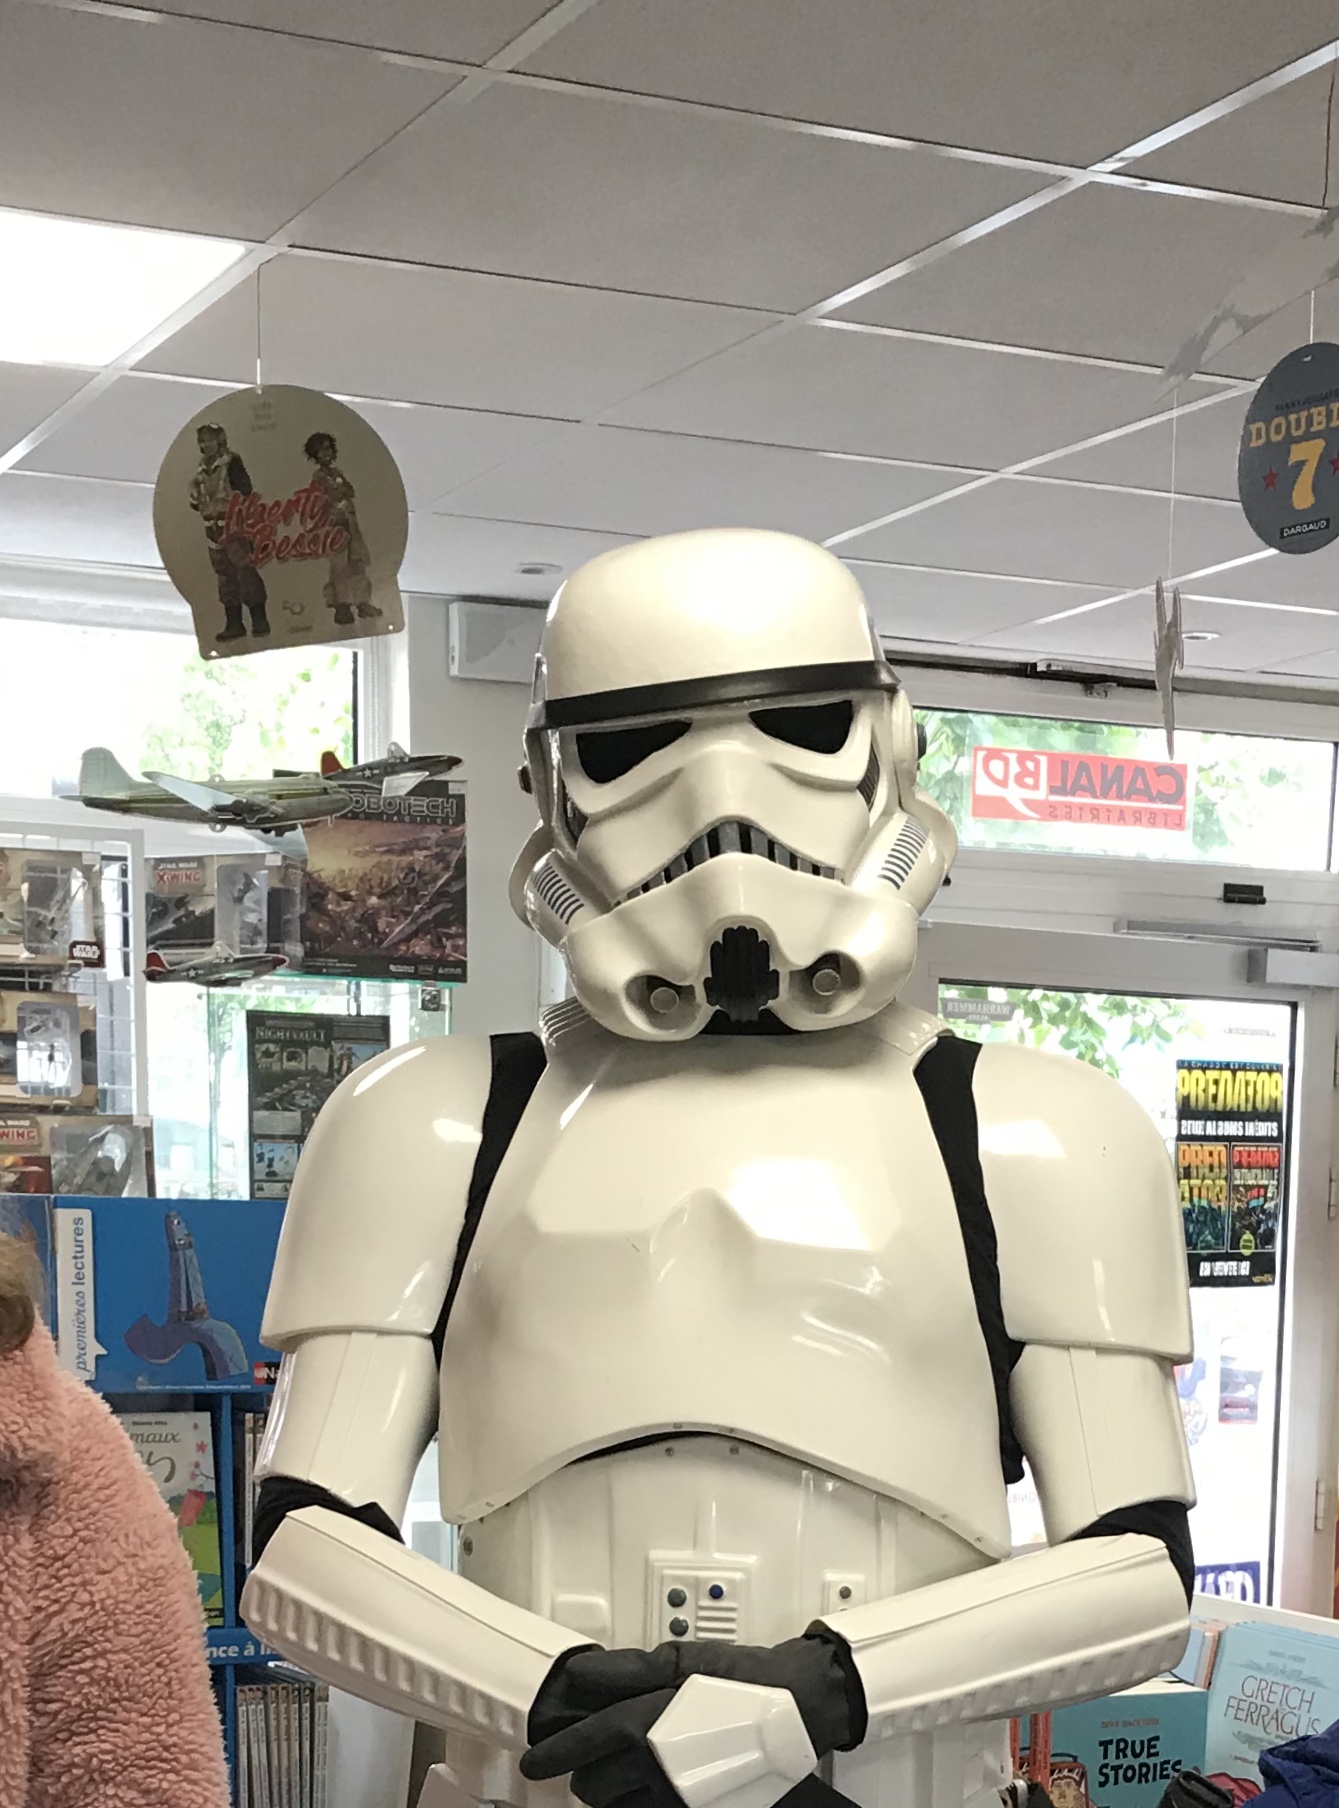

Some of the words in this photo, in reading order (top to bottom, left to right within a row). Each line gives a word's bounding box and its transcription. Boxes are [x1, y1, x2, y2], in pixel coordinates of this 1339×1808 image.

[1288, 438, 1326, 510] 7
[253, 523, 346, 568] Bessie
[1283, 520, 1326, 537] DARGAUD
[351, 793, 457, 817] OBOTECH
[1177, 1069, 1283, 1113] PREDATOR
[71, 1216, 86, 1286] lectures
[129, 1432, 181, 1443] maux
[1241, 1675, 1315, 1714] GRETCH
[1224, 1695, 1321, 1737] FERRAGUS
[1098, 1735, 1161, 1760] TRUE
[1098, 1759, 1183, 1789] STORIES
